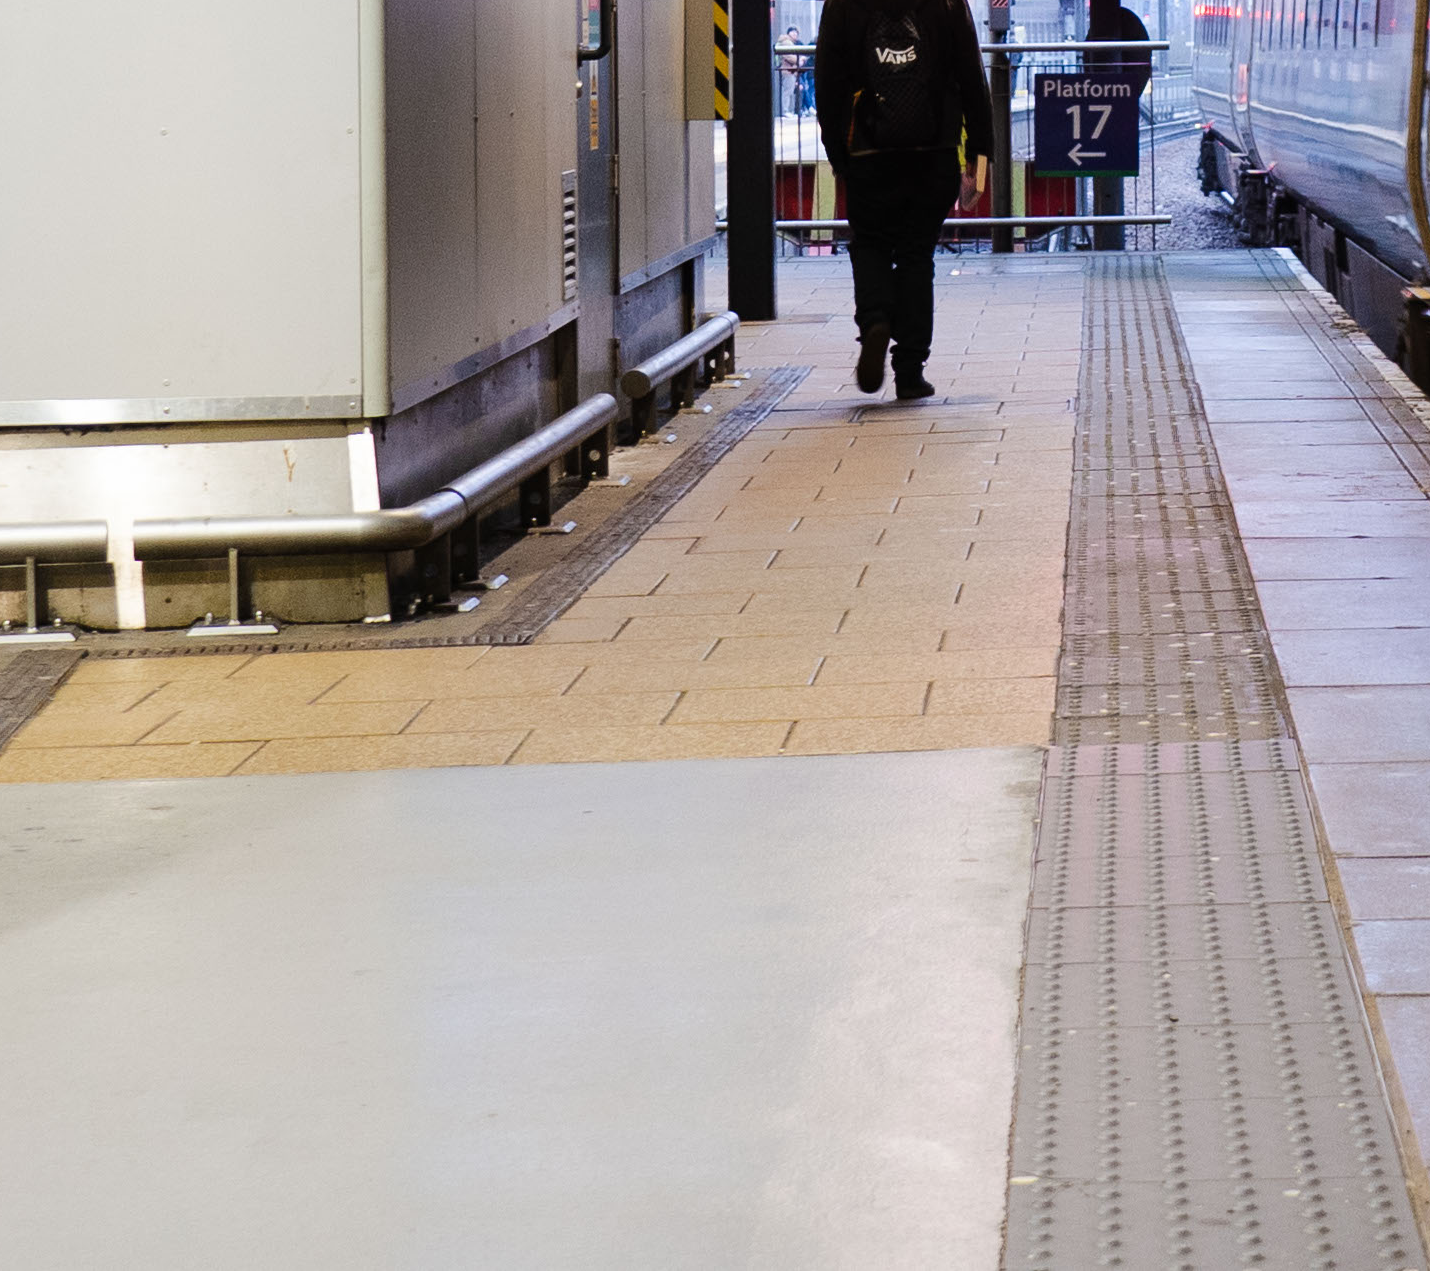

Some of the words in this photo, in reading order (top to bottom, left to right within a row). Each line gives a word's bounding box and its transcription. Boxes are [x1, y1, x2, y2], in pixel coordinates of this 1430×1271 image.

[875, 45, 917, 64] VANS
[1043, 79, 1131, 98] Platform
[1066, 105, 1113, 140] 17
